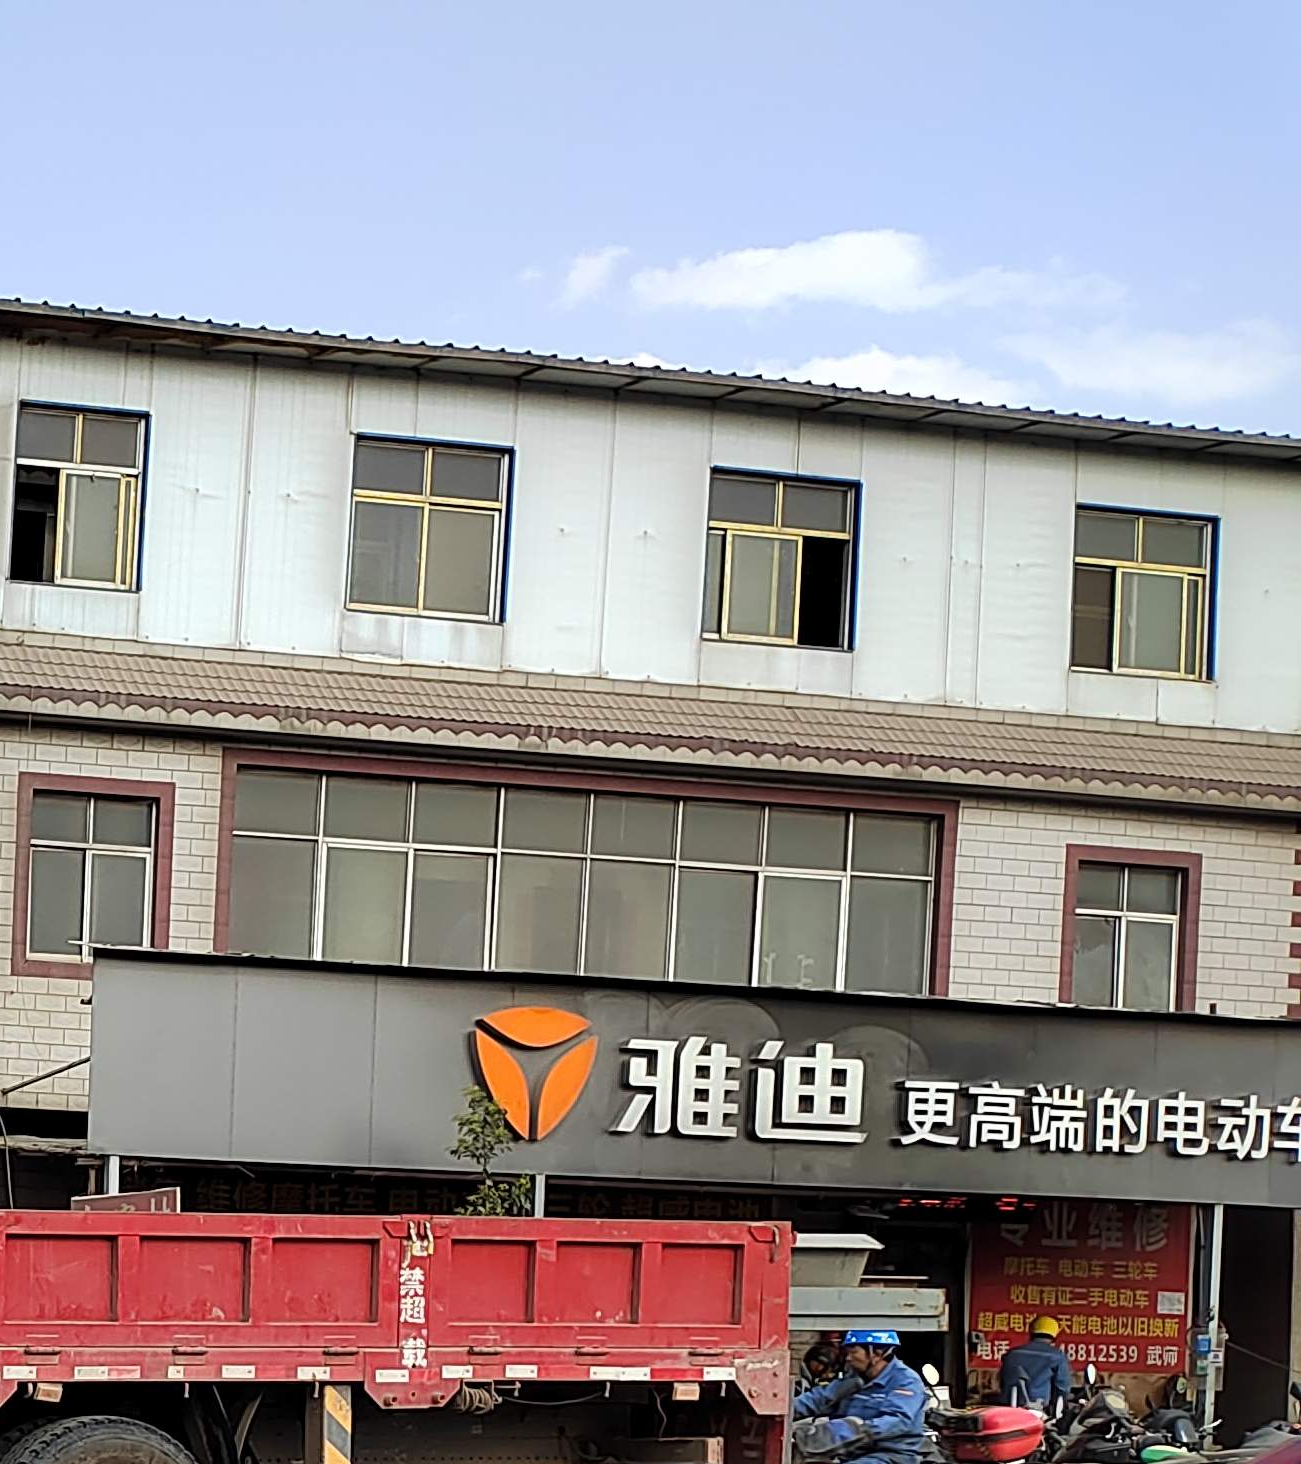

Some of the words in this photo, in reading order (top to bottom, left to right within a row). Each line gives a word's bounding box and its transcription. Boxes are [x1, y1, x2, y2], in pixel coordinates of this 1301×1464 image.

[608, 1036, 869, 1143] 雅迪
[1058, 1257, 1106, 1278] 电动车
[1111, 1260, 1158, 1281] 三轮车
